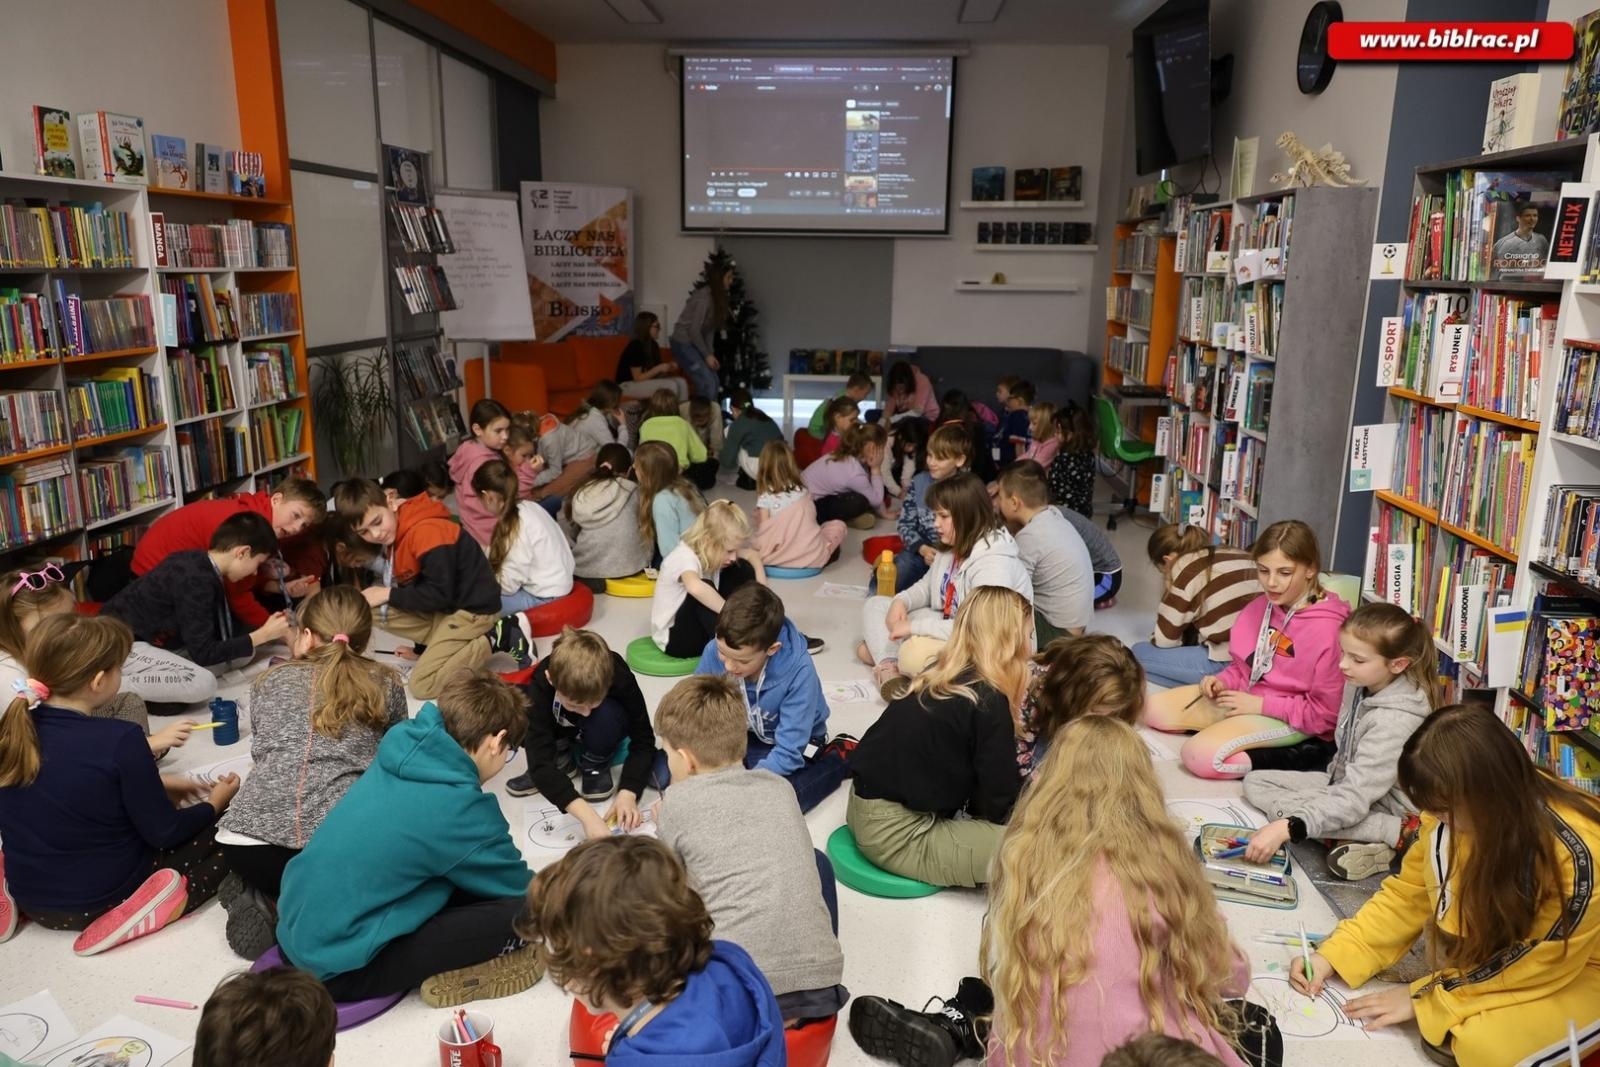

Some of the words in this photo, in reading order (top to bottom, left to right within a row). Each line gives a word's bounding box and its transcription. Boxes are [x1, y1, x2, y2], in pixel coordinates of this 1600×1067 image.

[154, 222, 165, 259] MANGA
[586, 230, 616, 242] NAS
[1557, 203, 1583, 257] NETFLIX
[534, 245, 625, 257] BIBLIOTEKA
[1384, 320, 1397, 361] SPORT
[1449, 326, 1463, 373] RYSUNEK
[1230, 375, 1241, 408] MINECRAFT
[1362, 427, 1370, 469] PLASTYCZNE
[1393, 564, 1401, 606] KOLOGIA
[1460, 587, 1470, 630] NARODOWE
[1460, 630, 1468, 653] PARKI
[143, 675, 161, 684] VIBES
